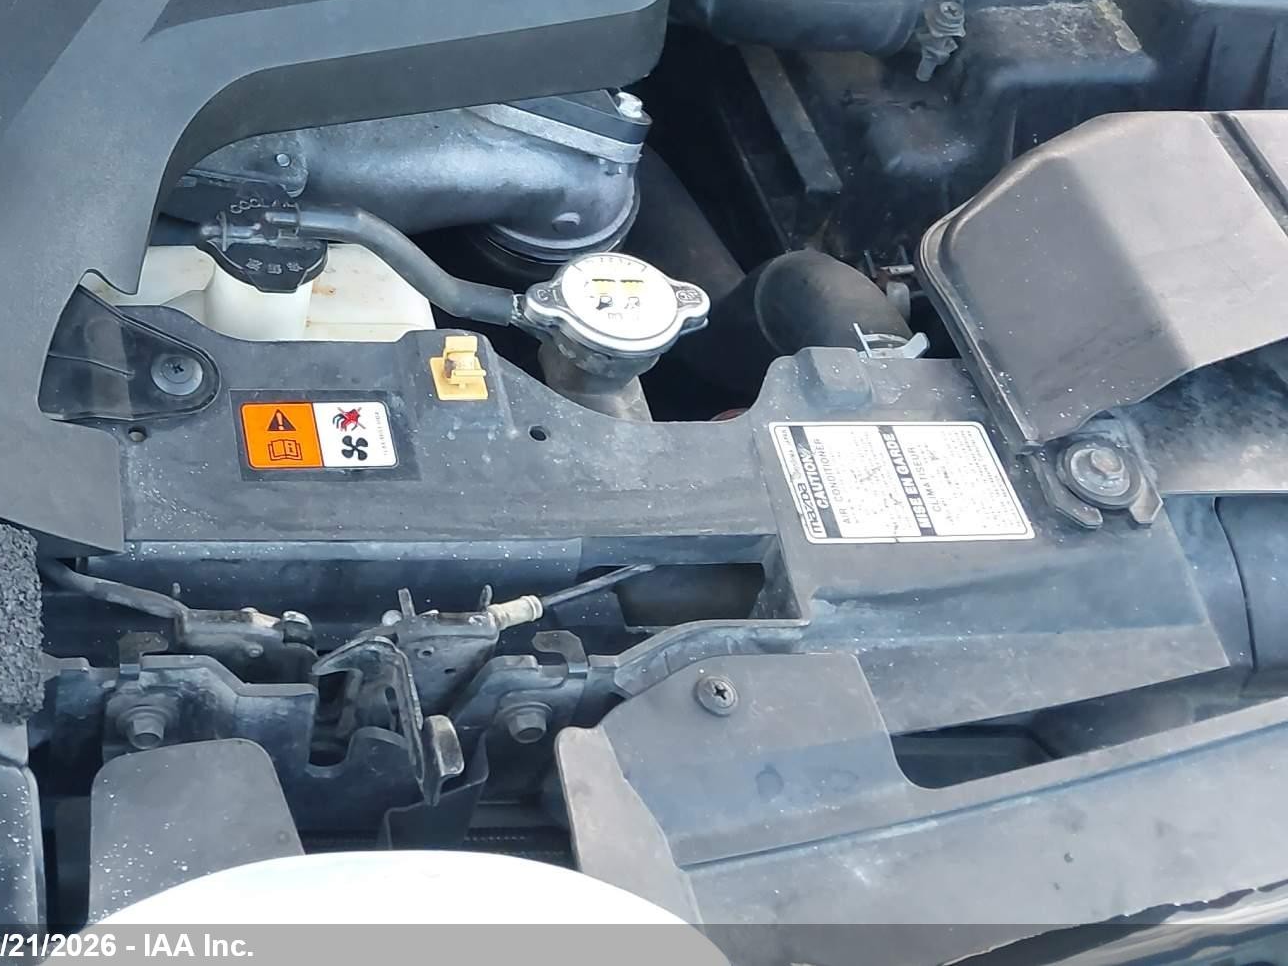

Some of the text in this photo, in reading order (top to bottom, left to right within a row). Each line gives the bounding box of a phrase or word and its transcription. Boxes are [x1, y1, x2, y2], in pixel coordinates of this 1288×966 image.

[799, 449, 830, 509] CAUTION
[813, 438, 852, 525] AIR CONDITIONER
[882, 433, 932, 528] MISE EN GARDE
[907, 447, 942, 512] CLIMATISEUR
